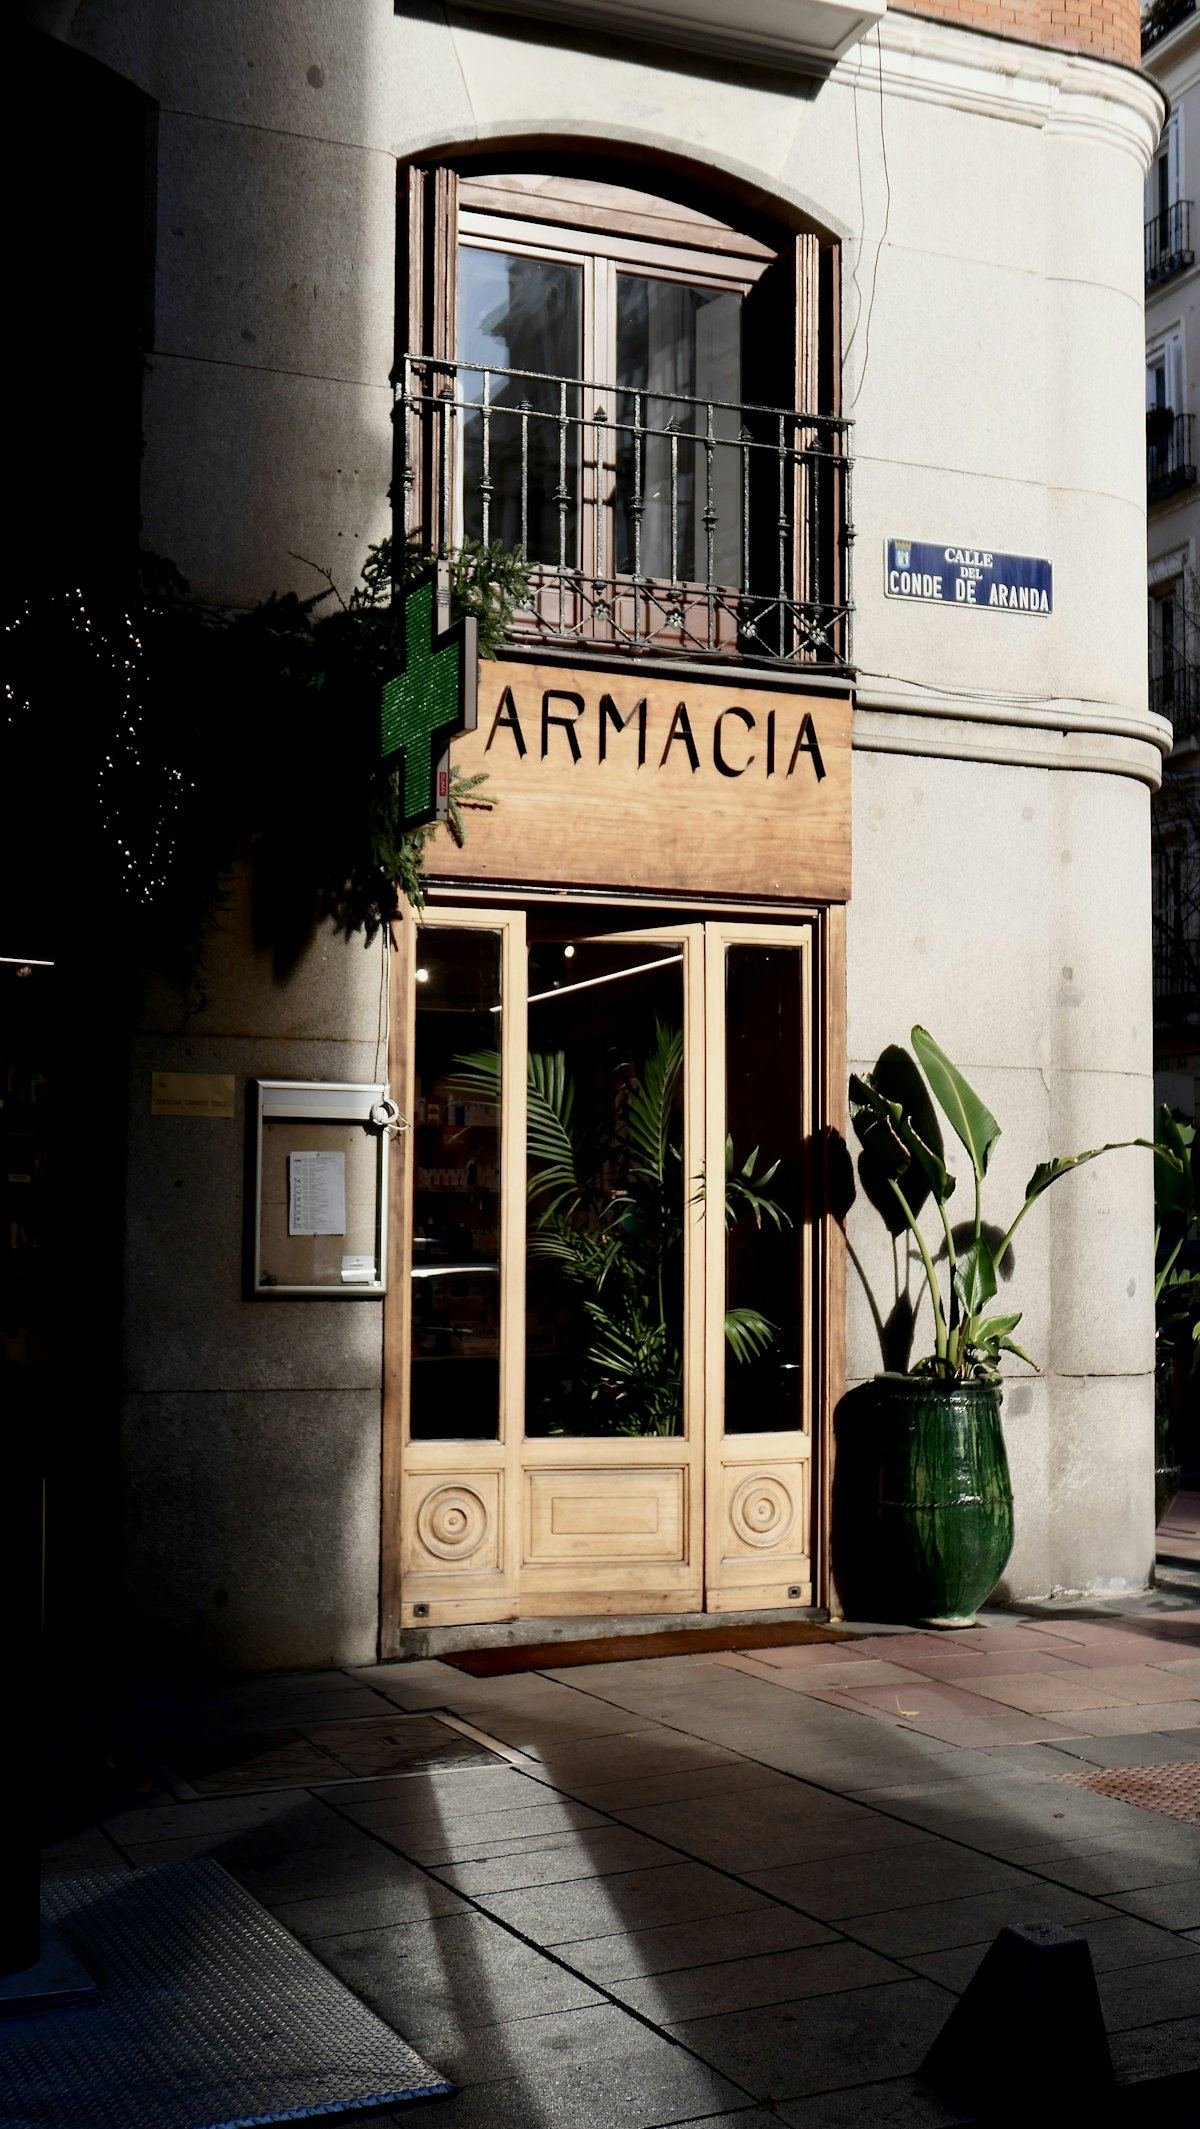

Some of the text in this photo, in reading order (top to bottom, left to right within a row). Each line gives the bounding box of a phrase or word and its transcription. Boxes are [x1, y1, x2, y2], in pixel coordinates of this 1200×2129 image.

[944, 547, 994, 568] CALLE
[960, 566, 983, 580] DEL
[890, 570, 1050, 612] CONDE DE ARANDA
[484, 685, 827, 783] ARMACIA
